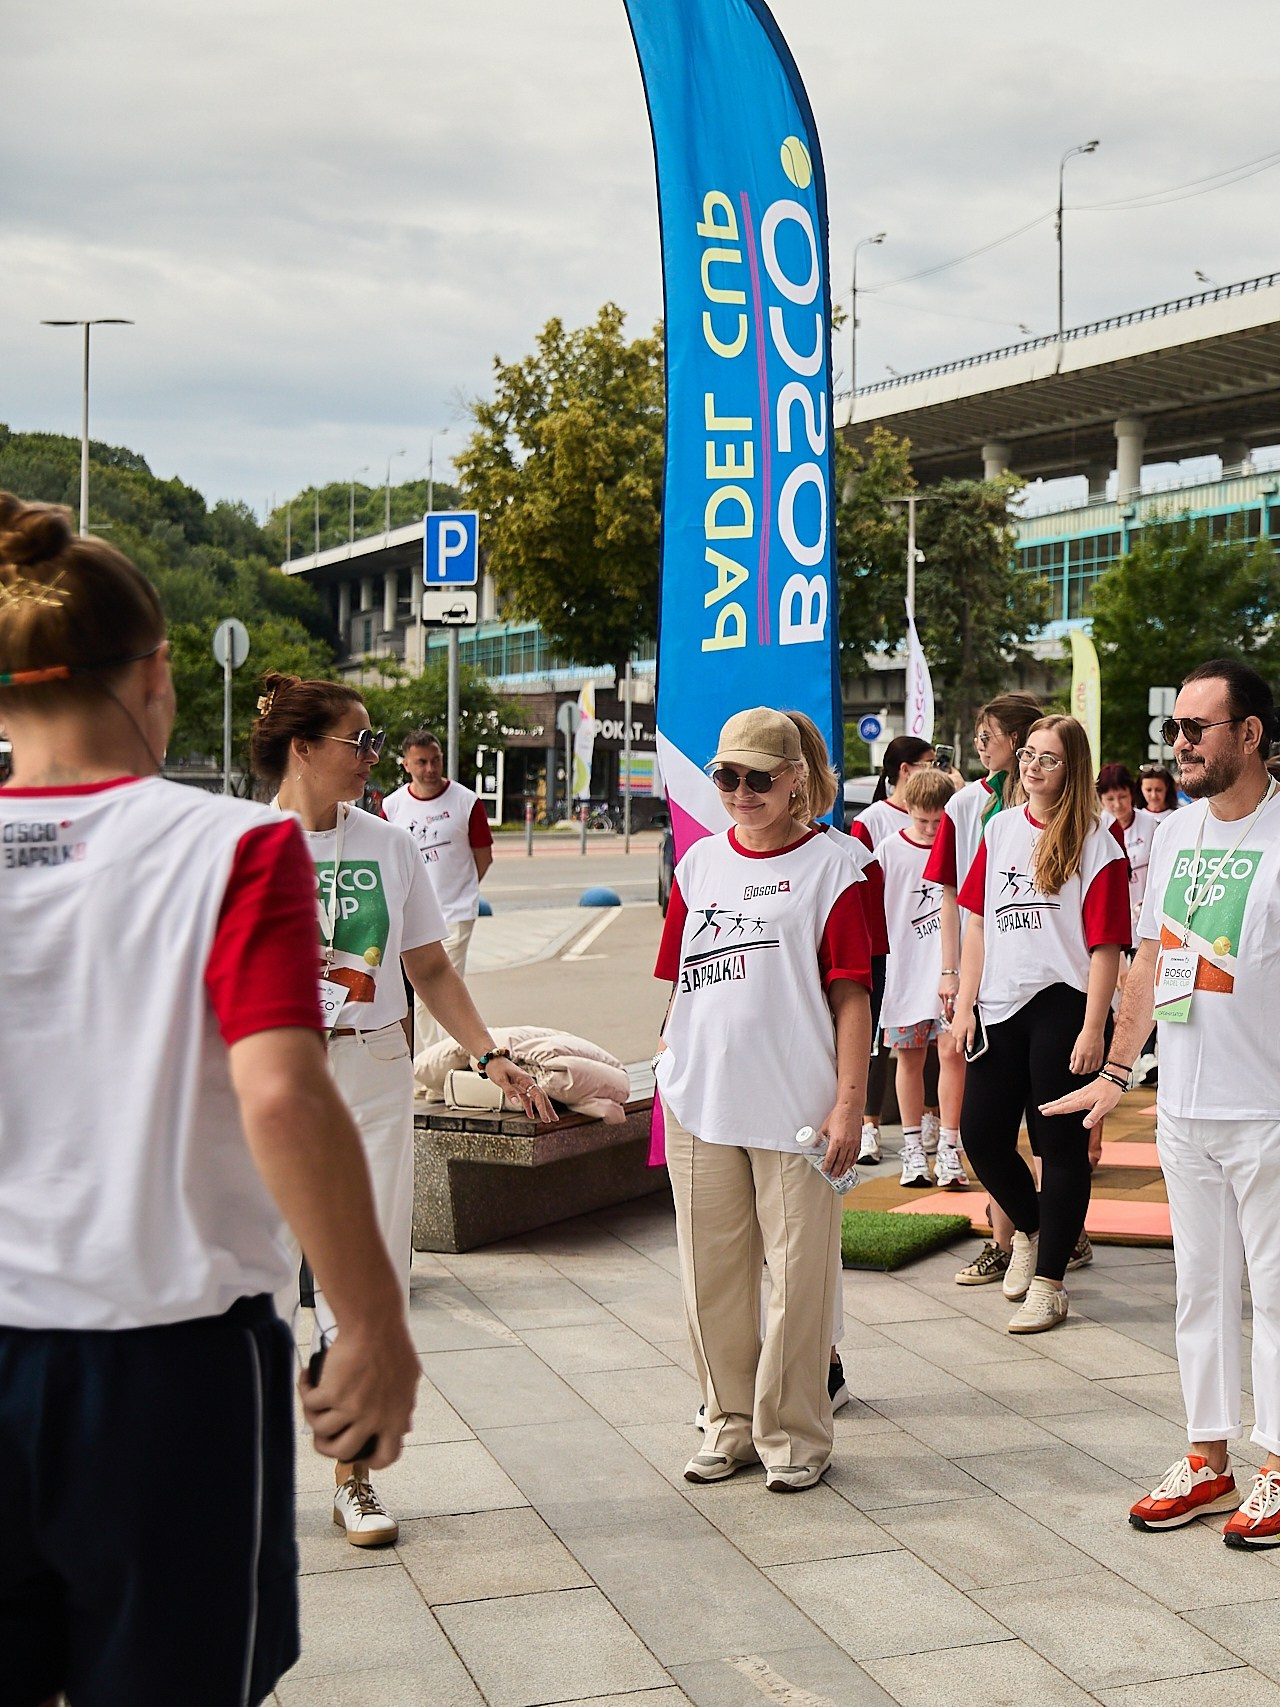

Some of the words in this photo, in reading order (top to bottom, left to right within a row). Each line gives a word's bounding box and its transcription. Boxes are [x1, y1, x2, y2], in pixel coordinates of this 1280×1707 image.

[438, 519, 468, 577] P
[3, 822, 57, 843] OSCO
[314, 868, 378, 893] SCO
[1173, 857, 1253, 880] BOSCO
[1184, 883, 1226, 907] CUP
[681, 954, 746, 994] ЗАРЯДКА
[1164, 967, 1192, 979] BOSCO
